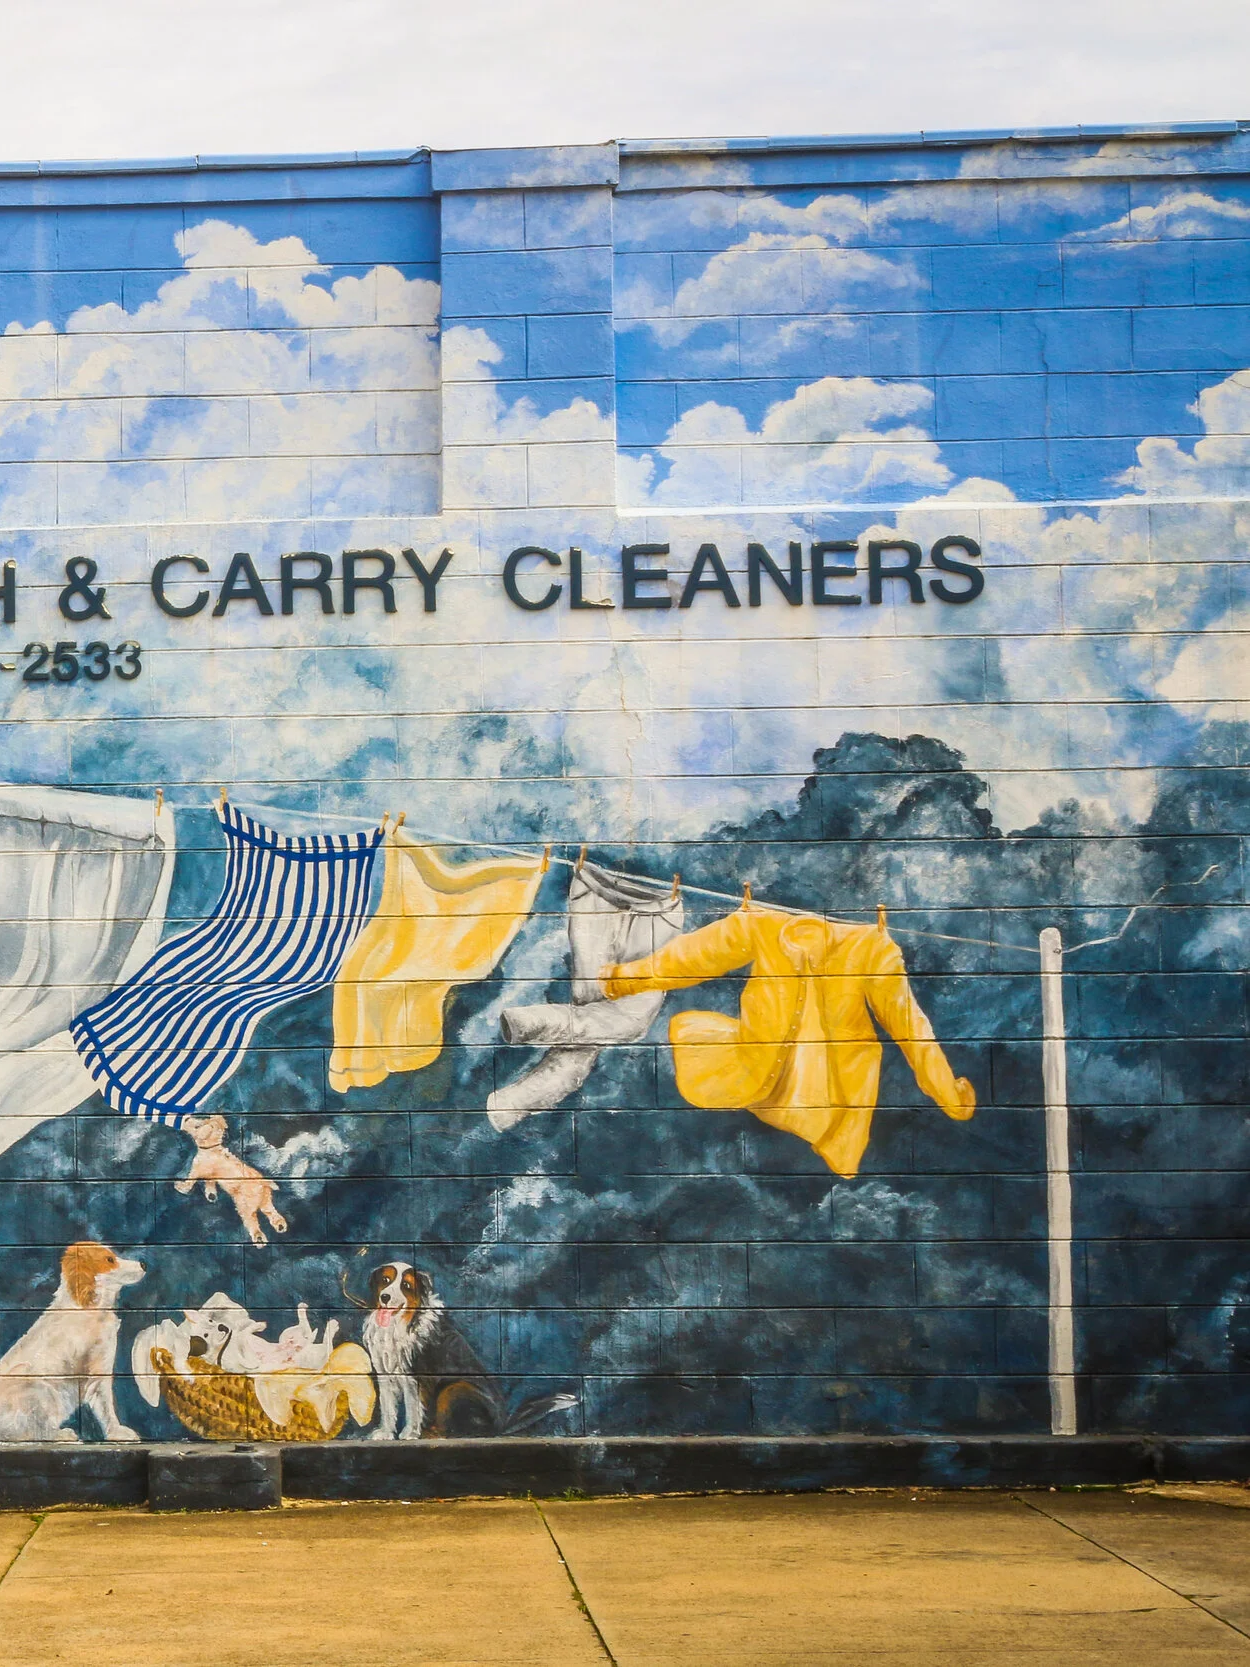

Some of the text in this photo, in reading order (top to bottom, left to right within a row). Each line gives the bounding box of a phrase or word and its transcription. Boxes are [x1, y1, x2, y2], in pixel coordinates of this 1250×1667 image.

[58, 556, 112, 621] &
[149, 546, 455, 618] CARRY
[502, 535, 986, 611] CLEANERS
